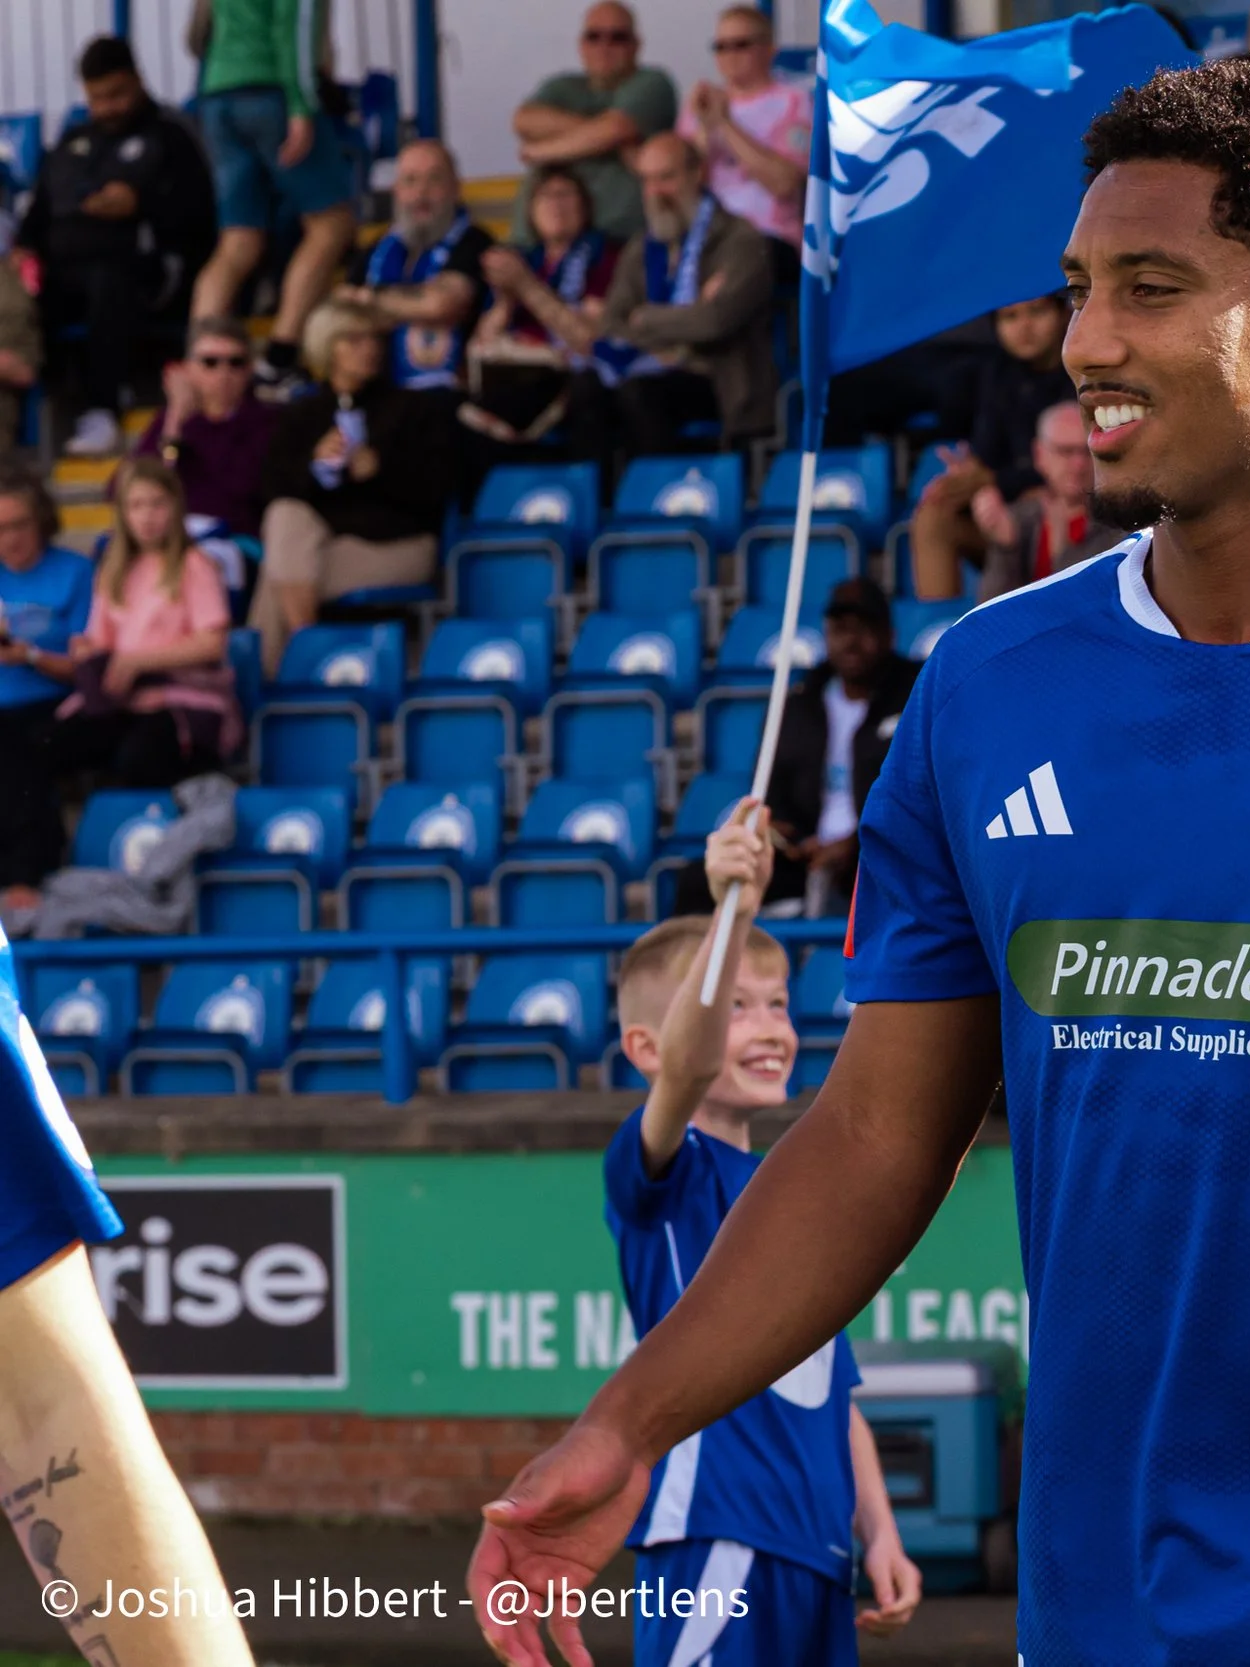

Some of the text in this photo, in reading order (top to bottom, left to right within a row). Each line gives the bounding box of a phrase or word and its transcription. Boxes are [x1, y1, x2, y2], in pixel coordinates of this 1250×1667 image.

[1051, 1023, 1162, 1051] Electrical
[92, 1215, 329, 1328] rise
[450, 1290, 559, 1370] THE
[873, 1288, 1030, 1350] LEAG
